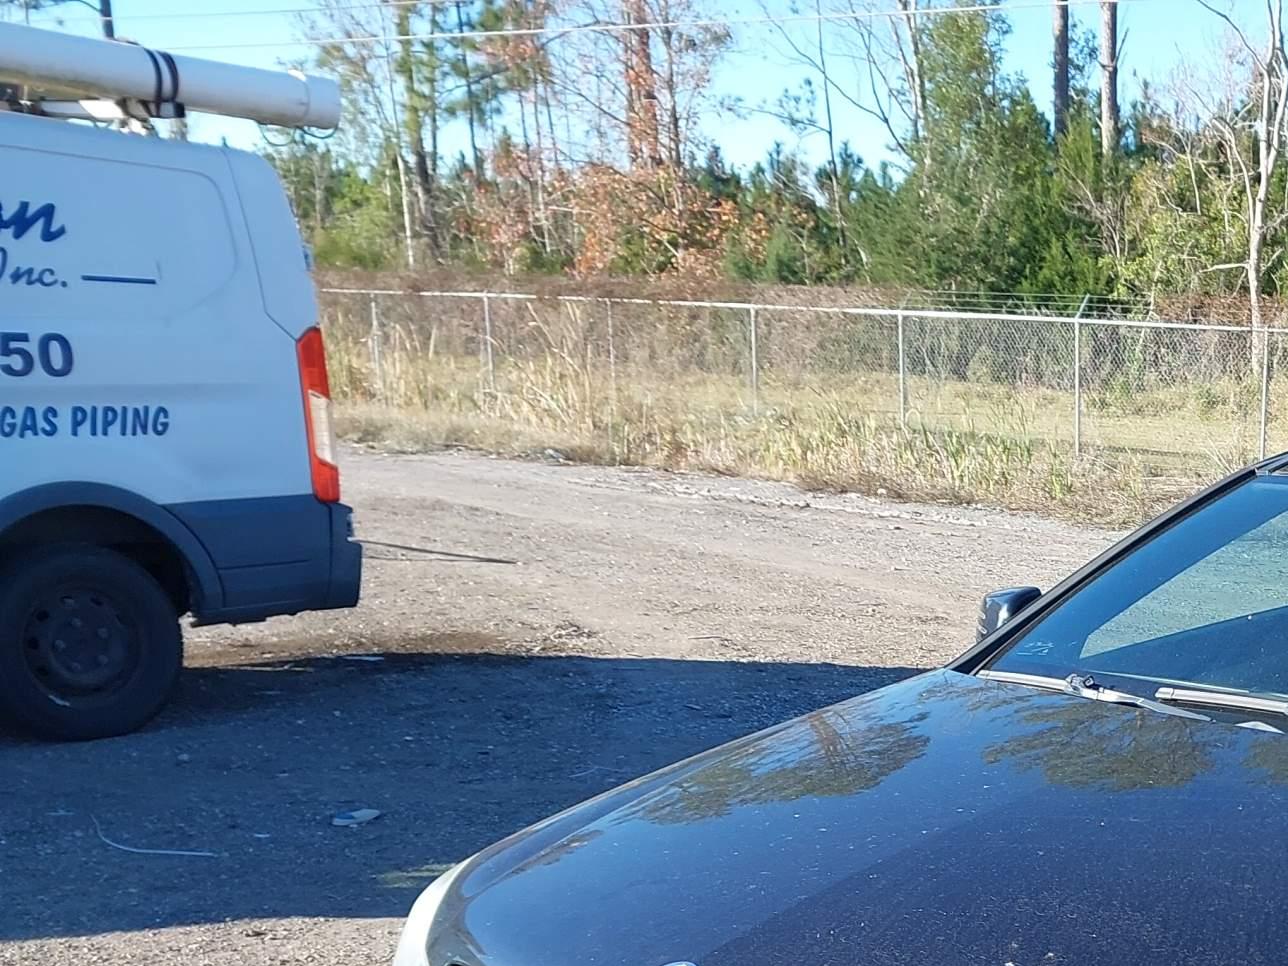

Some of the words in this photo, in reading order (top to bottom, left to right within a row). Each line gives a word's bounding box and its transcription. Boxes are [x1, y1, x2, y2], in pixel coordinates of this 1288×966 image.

[0, 331, 74, 378] 50
[0, 405, 58, 438] GAS
[71, 404, 169, 437] PIPING
